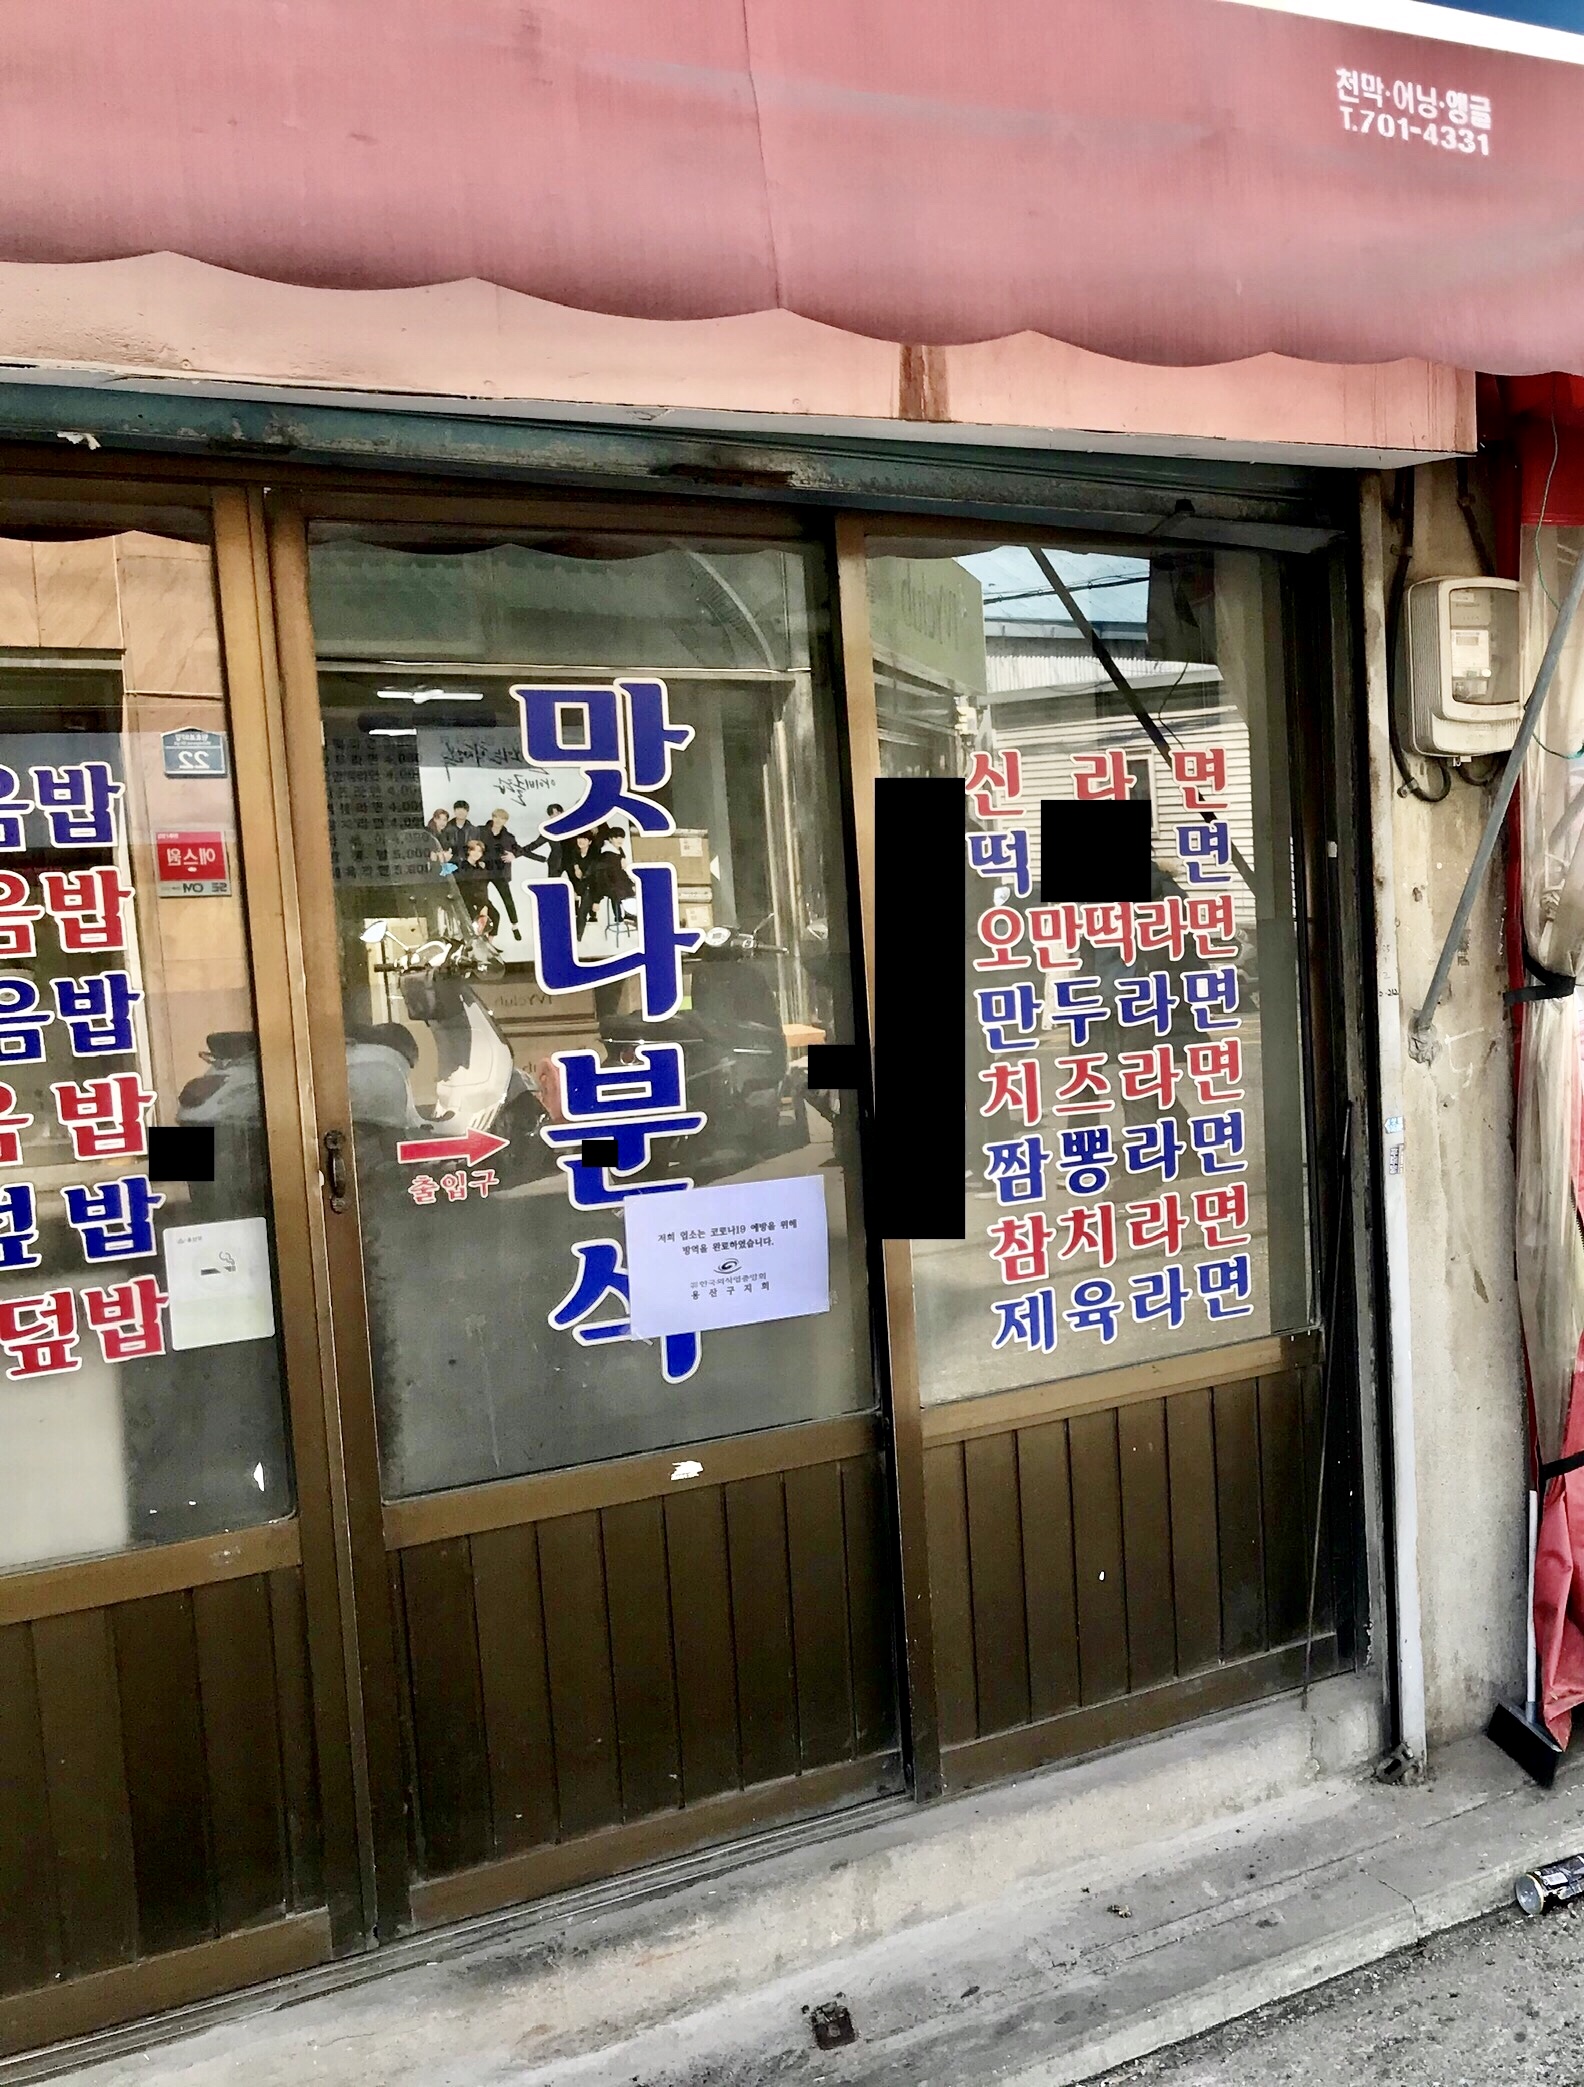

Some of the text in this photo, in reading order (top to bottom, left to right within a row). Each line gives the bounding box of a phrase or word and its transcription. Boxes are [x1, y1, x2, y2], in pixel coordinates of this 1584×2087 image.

[1339, 105, 1490, 156] T.701-4331
[973, 894, 1239, 972] 오만떡라면
[973, 965, 1241, 1053] 만두라면
[979, 1037, 1245, 1127] 치즈라면
[407, 1168, 500, 1205] 출입구
[983, 1108, 1248, 1206] 짬뽕라면
[658, 1218, 798, 1243] 저희 업소는 코로나19 예방을 위해
[682, 1236, 774, 1256] 방역을 완료하였습니다.
[987, 1181, 1251, 1285] 참치라면
[0, 1273, 169, 1381] 덮밥
[991, 1252, 1253, 1355] 제육라면
